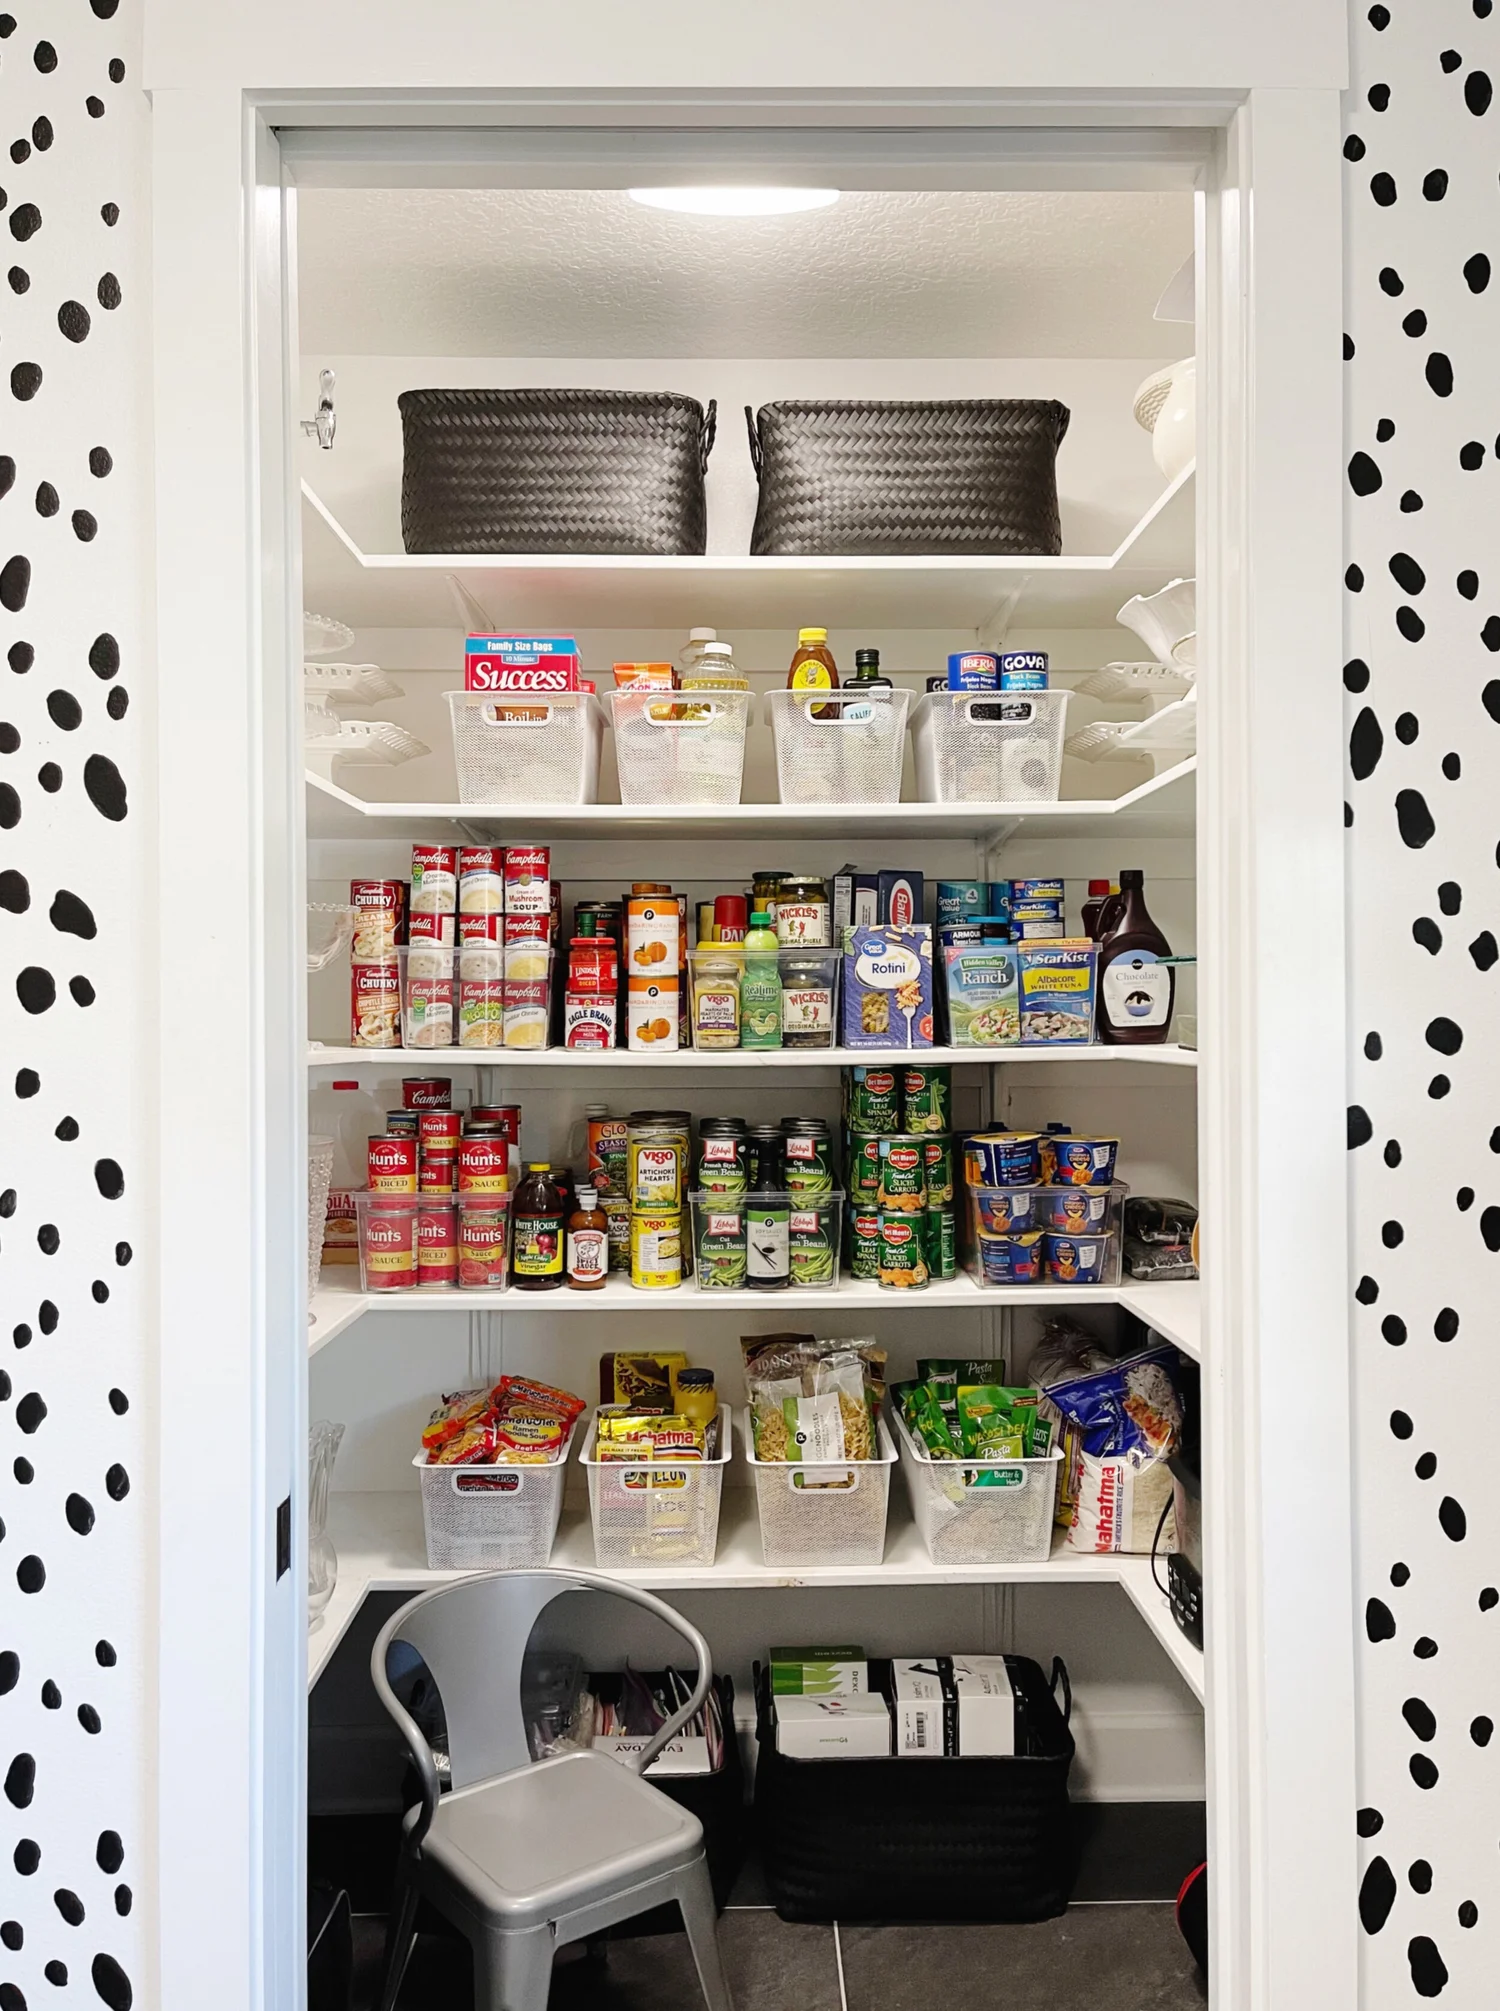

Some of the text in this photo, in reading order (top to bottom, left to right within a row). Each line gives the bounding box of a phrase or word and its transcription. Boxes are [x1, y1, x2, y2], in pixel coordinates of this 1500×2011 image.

[487, 641, 553, 652] Family Size Bags
[963, 658, 995, 669] IBERIA
[1004, 655, 1045, 671] GOYA
[472, 661, 568, 691] Success
[506, 850, 546, 866] Campbell's
[355, 894, 392, 907] CHUNKY
[938, 896, 961, 905] Great
[896, 891, 909, 927] Barill
[941, 904, 961, 912] Value
[1035, 951, 1090, 964] StarKist
[871, 962, 906, 974] Rotini
[963, 959, 1004, 968] Hidden Valley
[575, 966, 601, 978] LINDSAY
[962, 969, 1008, 985] Ranch
[1115, 971, 1160, 982] Chocolate
[360, 977, 397, 990] CHUNKY
[1037, 975, 1076, 984] Albacore
[411, 983, 450, 997] Campbell's
[464, 984, 502, 998] Campbell's
[568, 1009, 613, 1027] EAGLE BRAND
[873, 1102, 888, 1110] LEAF
[867, 1108, 893, 1116] SPINACH
[423, 1122, 448, 1132] Hunt's
[601, 1124, 627, 1138] GLO
[598, 1138, 627, 1151] SEASO
[709, 1143, 732, 1155] Libby's
[788, 1142, 810, 1154] Libby's
[369, 1152, 408, 1166] Hunt's
[462, 1152, 502, 1166] Hunt's
[890, 1154, 918, 1162] Del Monte
[720, 1168, 743, 1176] Beans
[799, 1166, 824, 1175] Beans
[380, 1179, 408, 1187] DICED
[474, 1180, 502, 1188] SAUCE
[893, 1179, 915, 1187] SLICED
[889, 1185, 918, 1193] CARROTS
[533, 1219, 559, 1230] HOUSE
[714, 1218, 737, 1230] Libby's
[791, 1216, 814, 1228] Libby's
[419, 1225, 447, 1238] unt's
[463, 1227, 502, 1243] Hunt's
[701, 1242, 724, 1251] Green
[802, 1239, 826, 1248] Beans
[420, 1251, 447, 1259] DICED
[856, 1252, 878, 1260] SPINAC
[374, 1257, 403, 1265] SAUCE
[883, 1260, 911, 1268] CARROTS
[520, 1263, 546, 1271] Vinegar
[966, 1361, 993, 1376] Pasta
[512, 1425, 539, 1434] Ramen
[529, 1431, 549, 1442] Soup
[514, 1443, 533, 1451] Beef
[981, 1445, 1011, 1460] Pasta
[993, 1470, 1019, 1479] Butter &
[1095, 1466, 1116, 1552] Mahatma
[613, 1745, 684, 1753] EVDAY
